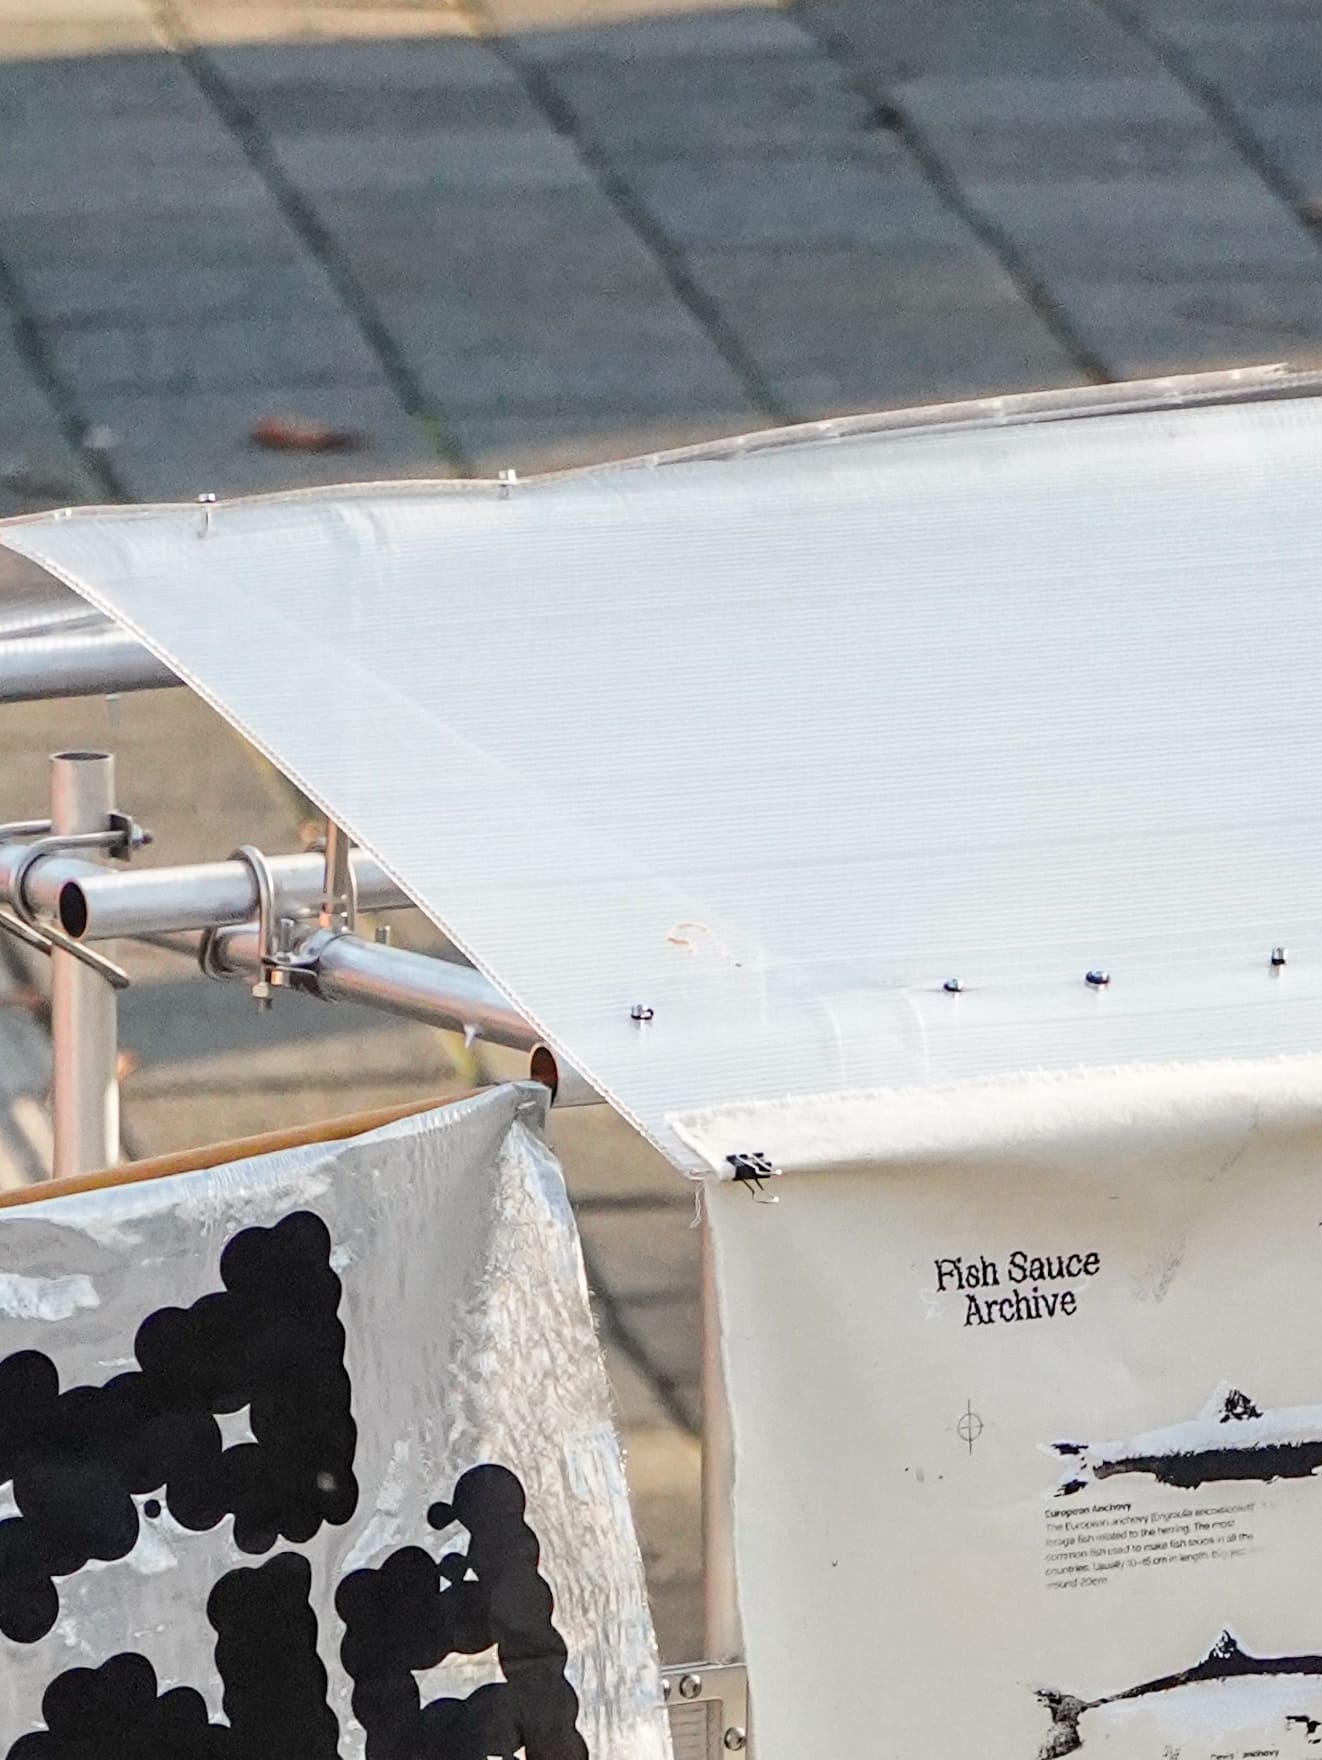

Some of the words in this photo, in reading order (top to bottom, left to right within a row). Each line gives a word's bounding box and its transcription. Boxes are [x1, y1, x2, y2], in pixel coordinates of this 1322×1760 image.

[934, 1257, 1000, 1292] Fish
[1008, 1251, 1100, 1285] Sauce
[963, 1288, 1077, 1327] Archive
